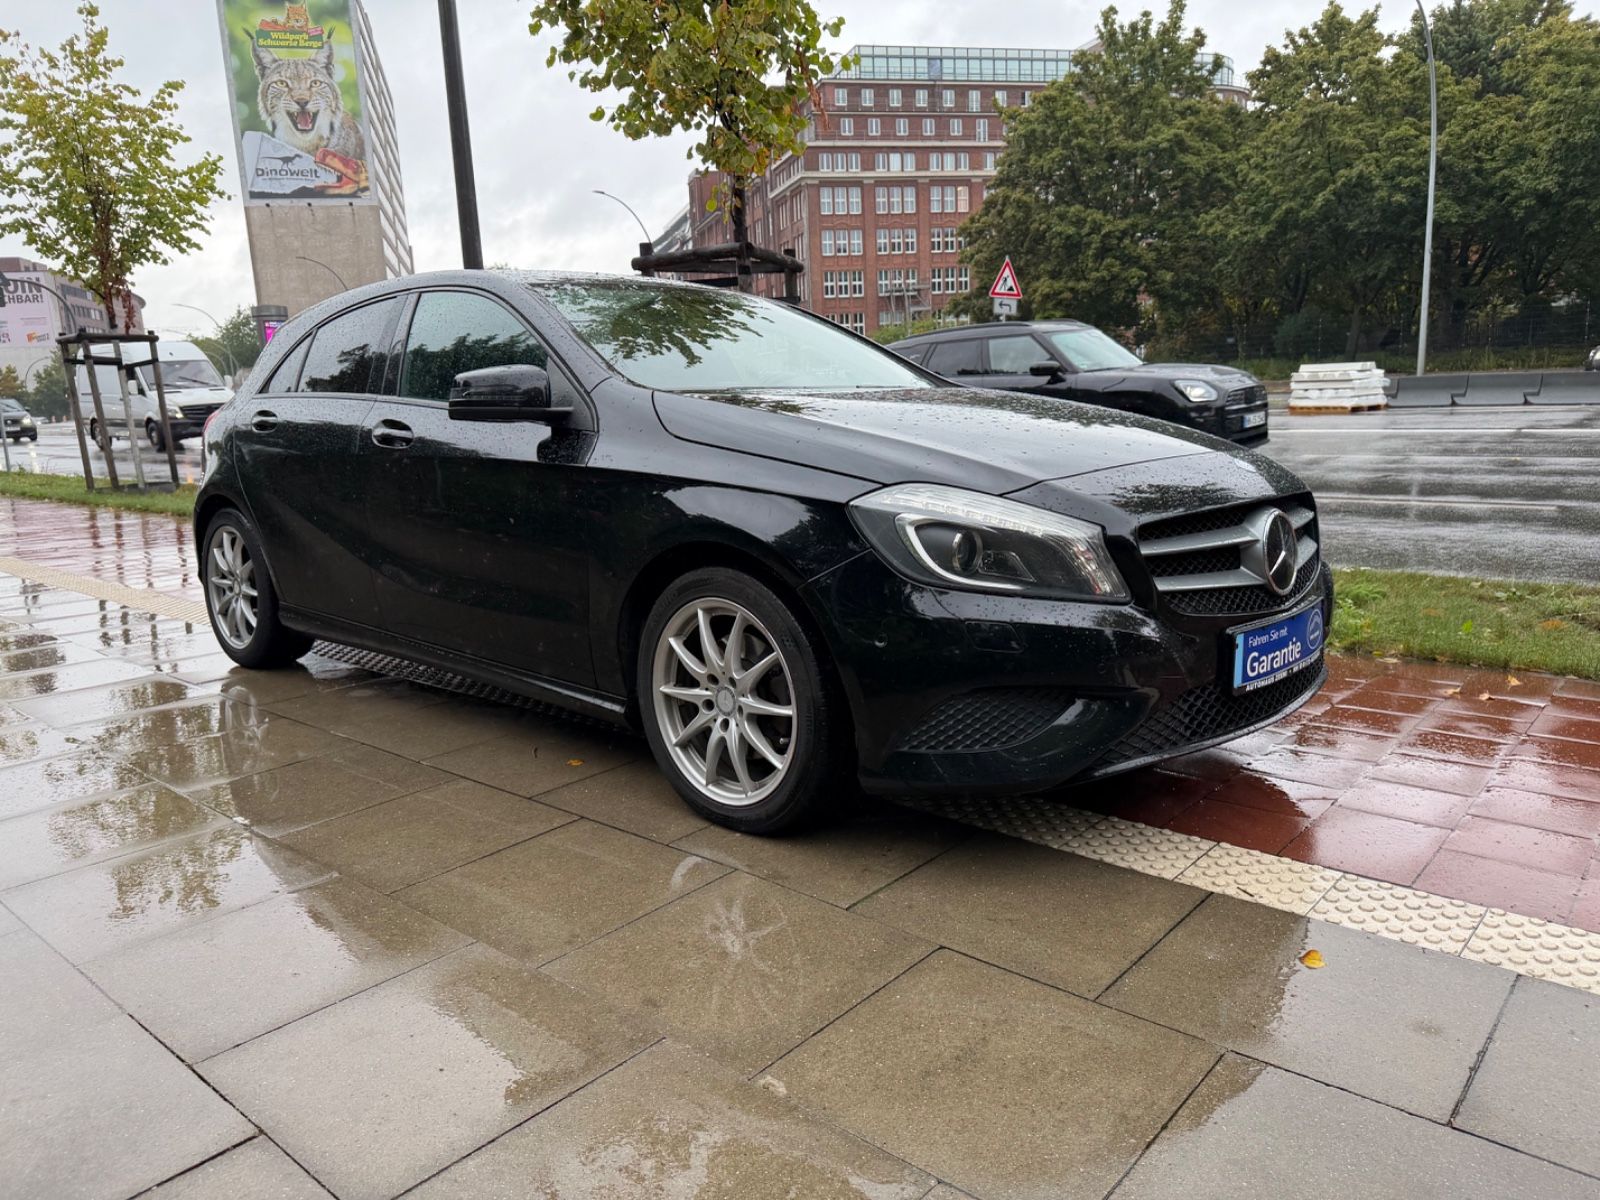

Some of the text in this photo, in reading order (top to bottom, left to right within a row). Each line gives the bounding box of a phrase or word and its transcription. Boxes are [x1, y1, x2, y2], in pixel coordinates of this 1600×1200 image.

[256, 167, 320, 178] Dinowelt
[1248, 626, 1288, 648] Fahren Sie mit
[1246, 637, 1302, 677] Garantie
